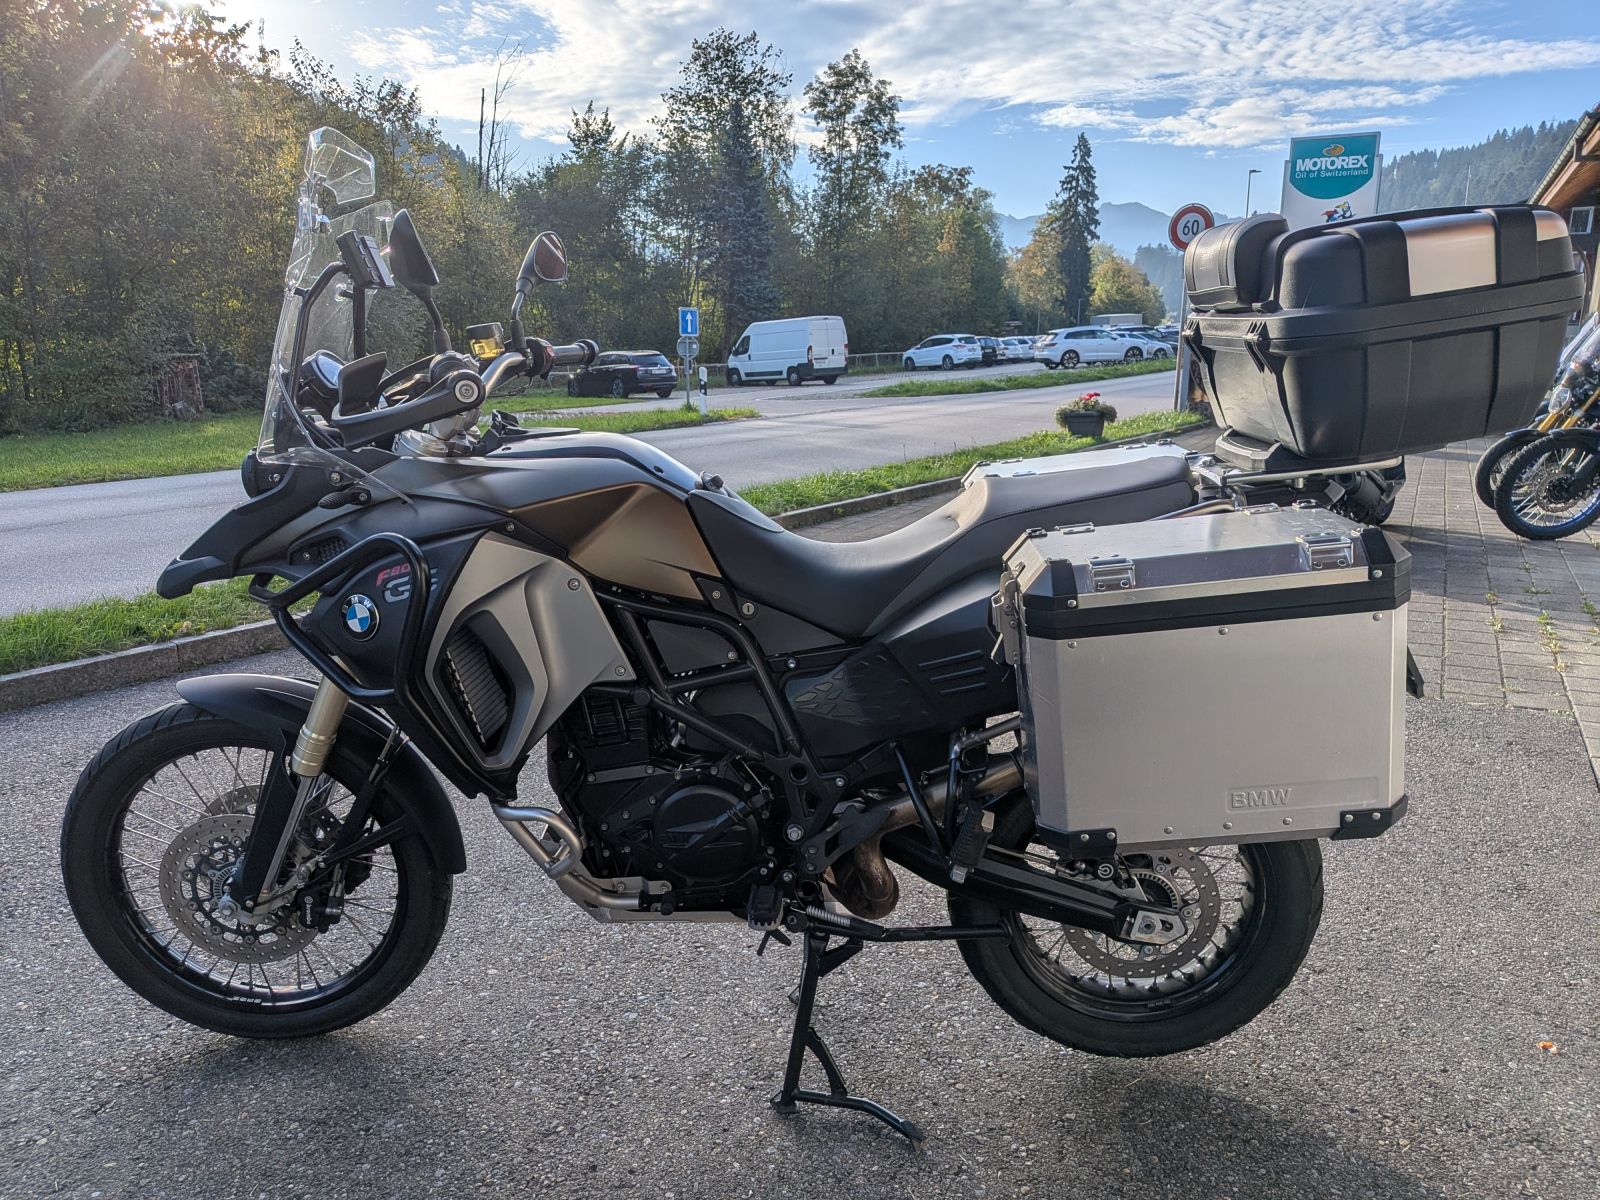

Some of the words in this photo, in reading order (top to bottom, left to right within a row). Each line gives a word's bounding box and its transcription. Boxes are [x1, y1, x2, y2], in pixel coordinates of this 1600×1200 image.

[1296, 154, 1369, 172] MOTOREX
[1295, 171, 1307, 179] Oil
[1309, 170, 1318, 178] of
[1320, 168, 1369, 178] Switzerland
[1182, 219, 1200, 236] 60
[375, 562, 411, 588] F80
[342, 596, 372, 614] BMW
[1231, 788, 1292, 808] BMW
